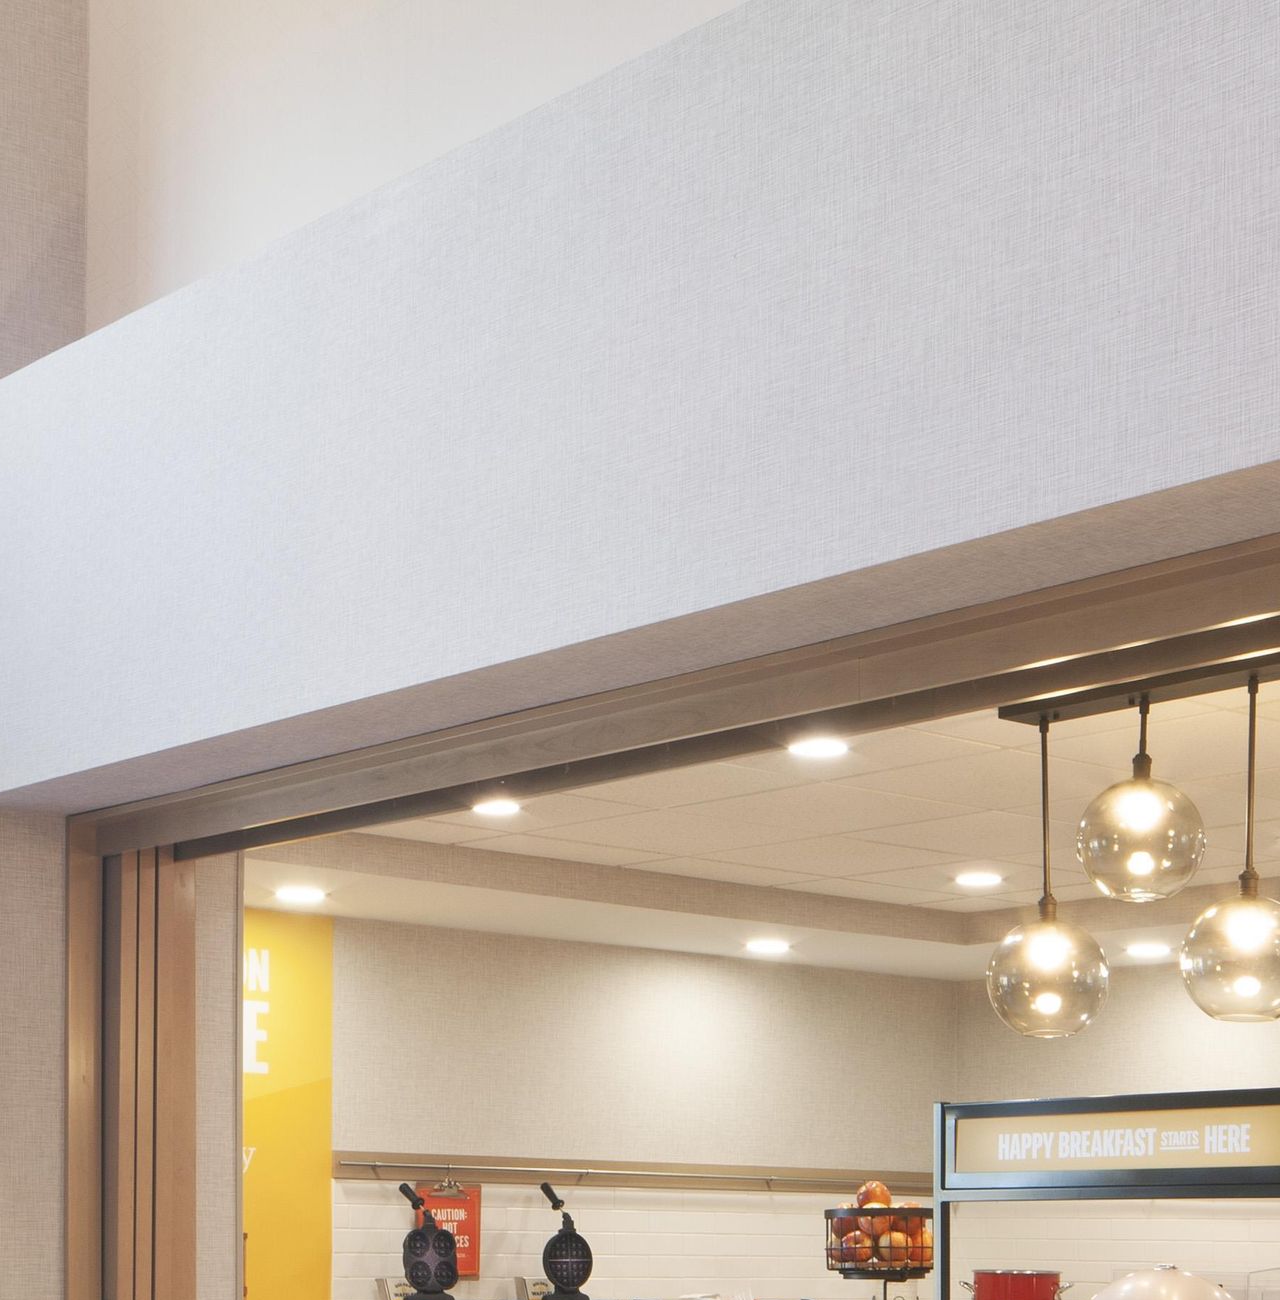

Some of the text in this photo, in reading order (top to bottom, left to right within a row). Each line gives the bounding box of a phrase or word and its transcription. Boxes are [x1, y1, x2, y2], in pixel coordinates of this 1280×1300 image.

[998, 1124, 1251, 1160] HAPPY BREAKFAST STARTS HERE
[431, 1208, 468, 1220] CAUTION:
